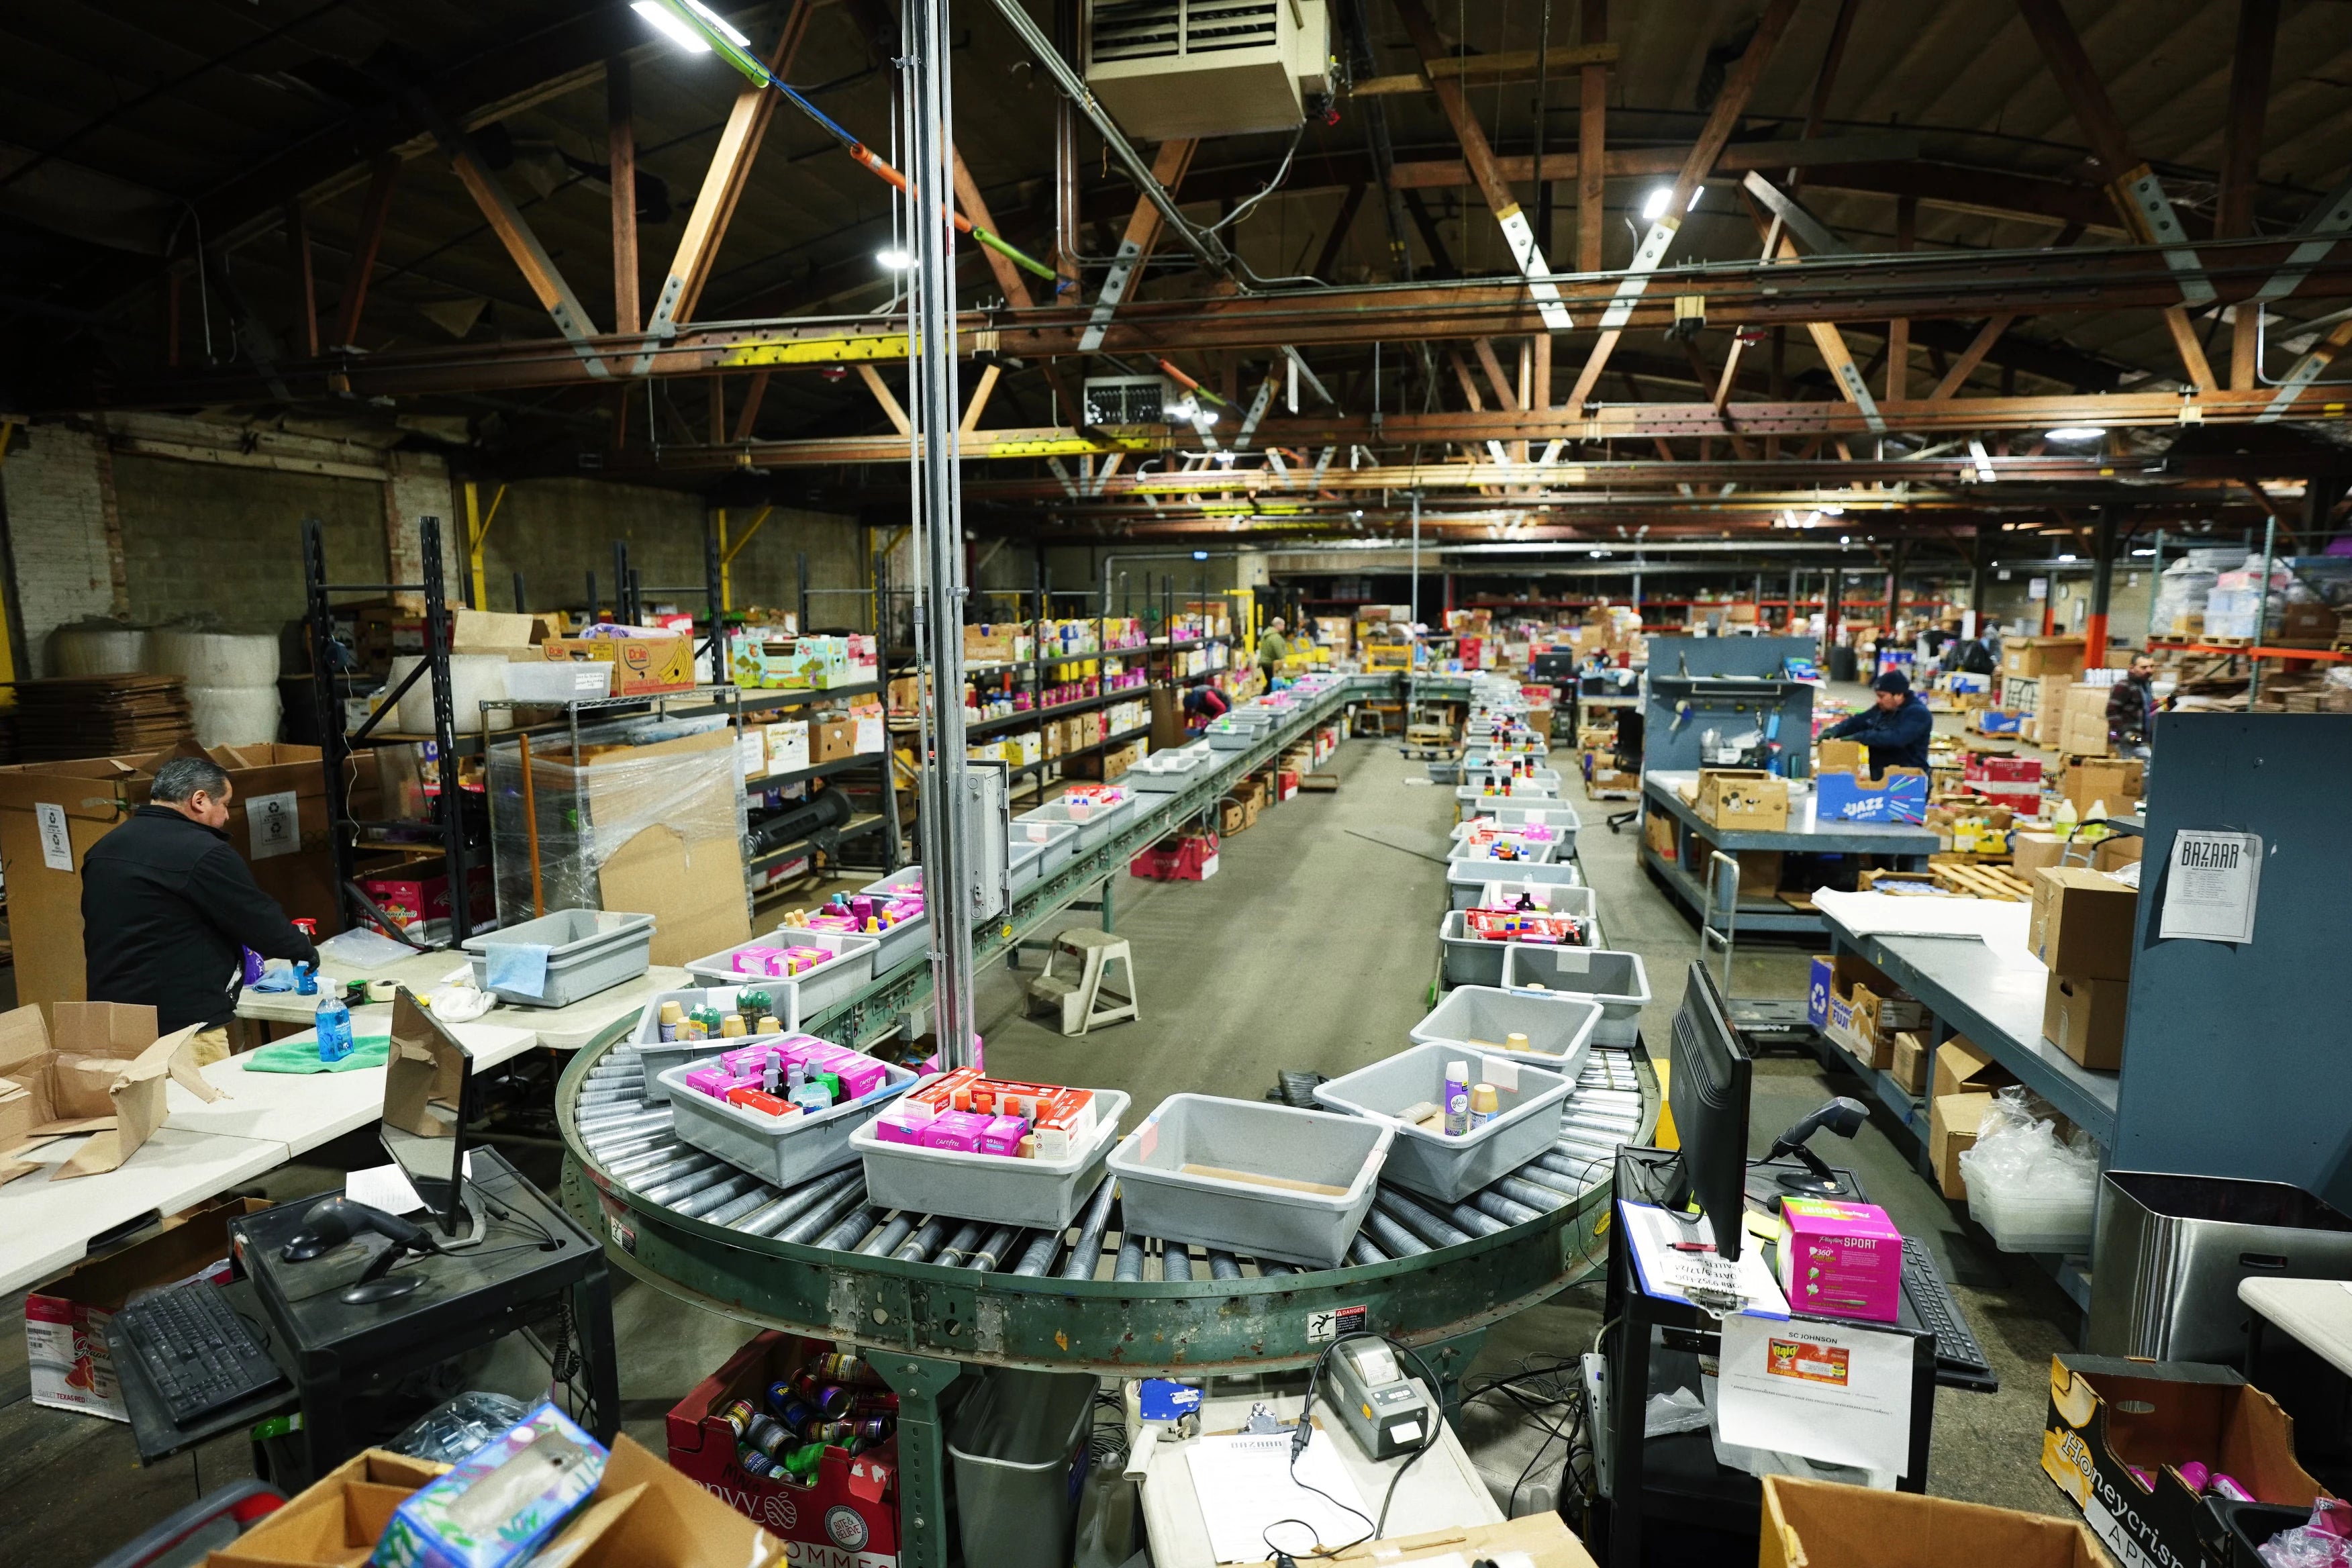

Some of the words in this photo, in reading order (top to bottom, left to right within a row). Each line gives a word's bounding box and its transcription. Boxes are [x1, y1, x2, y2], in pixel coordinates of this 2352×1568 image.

[629, 649, 646, 658] Dole
[1845, 797, 1884, 816] JAZZ
[2181, 841, 2239, 869] BAZAAR
[1832, 1009, 1849, 1030] FUJI
[859, 1074, 877, 1087] Carefree
[936, 1138, 960, 1147] Carefree
[1844, 1238, 1877, 1249] SPORT
[1342, 1307, 1365, 1315] DANGER
[1800, 1334, 1837, 1344] JOHNSON
[75, 1336, 110, 1361] Grape
[1773, 1345, 1797, 1357] Raid
[38, 1389, 56, 1398] SWEET
[56, 1393, 75, 1401] TEXAS
[834, 1519, 848, 1530] BITE
[846, 1517, 854, 1525] &
[836, 1524, 861, 1540] BELIEVE
